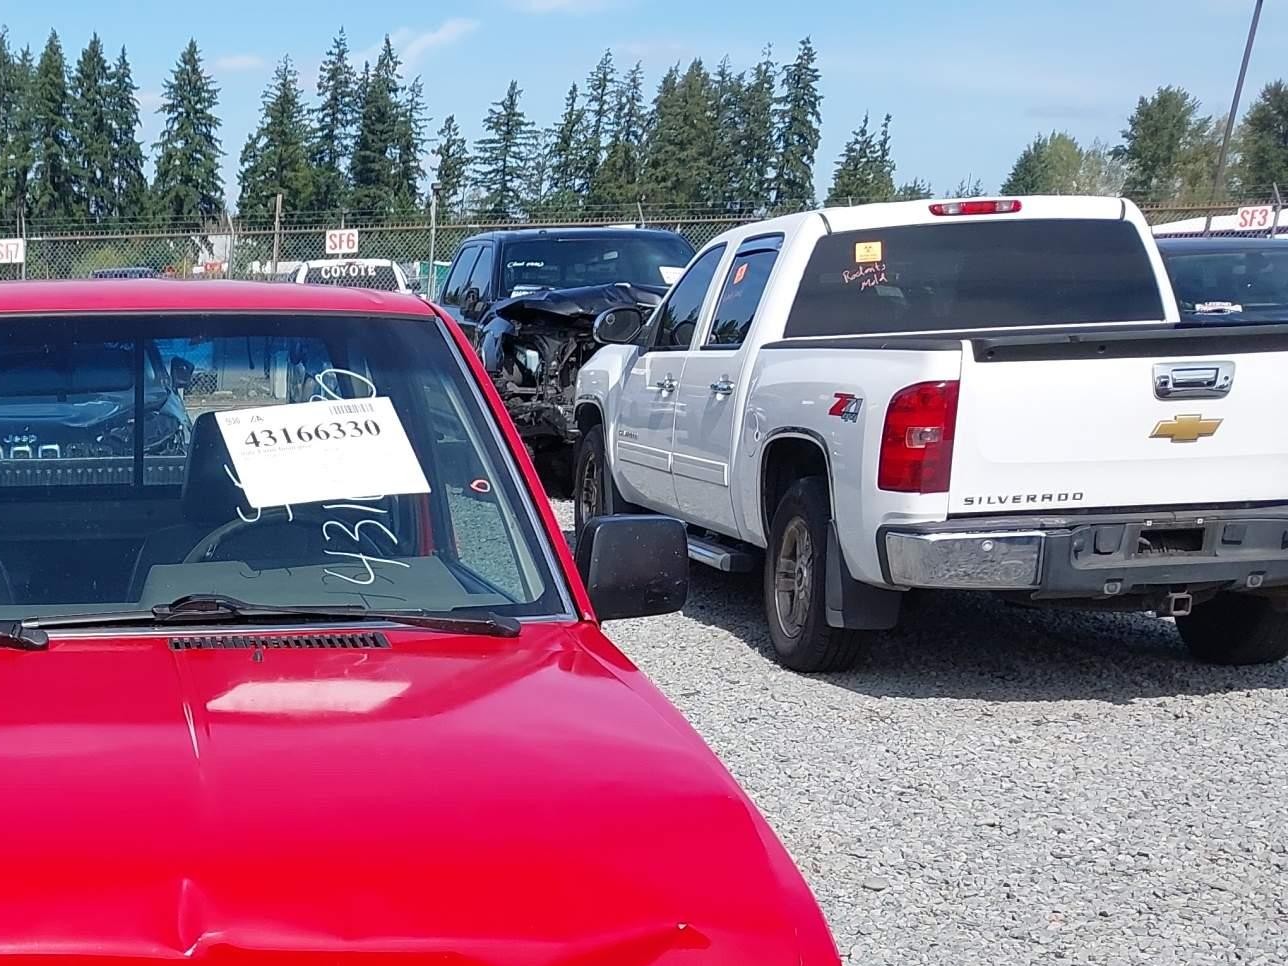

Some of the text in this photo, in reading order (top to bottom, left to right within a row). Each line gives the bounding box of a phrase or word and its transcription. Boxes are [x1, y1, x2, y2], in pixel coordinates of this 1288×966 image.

[1239, 209, 1269, 228] SF3
[329, 232, 356, 250] SF6
[320, 264, 377, 279] COYOTE
[3, 434, 38, 444] Jeep
[244, 418, 382, 448] 43166330
[963, 492, 1084, 506] SILVERADO
